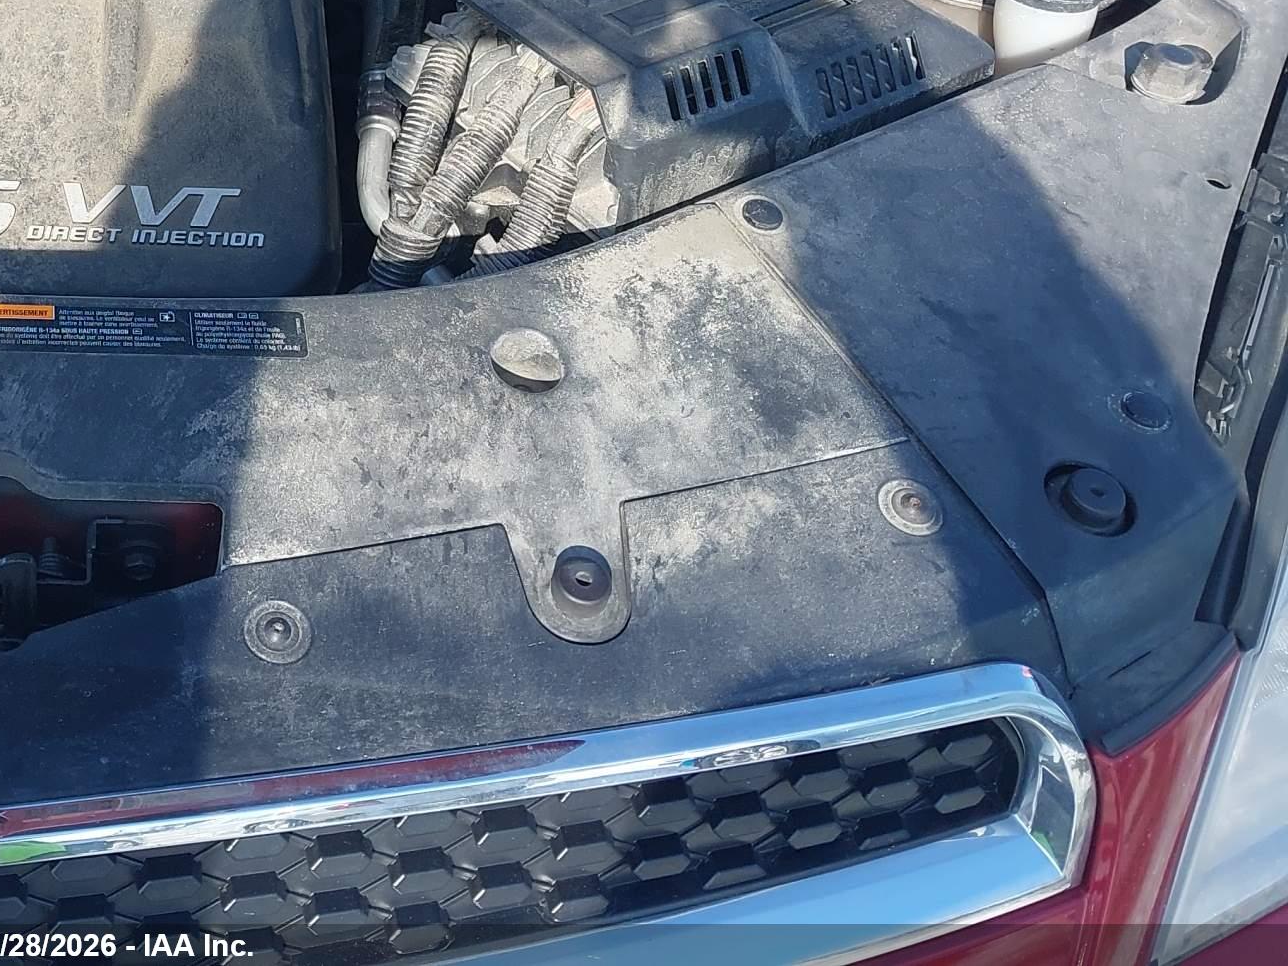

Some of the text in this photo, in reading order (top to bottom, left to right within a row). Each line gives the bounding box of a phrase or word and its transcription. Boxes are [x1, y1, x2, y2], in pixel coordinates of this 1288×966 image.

[63, 182, 242, 227] VVT
[26, 225, 265, 247] DIRECT INJECTION
